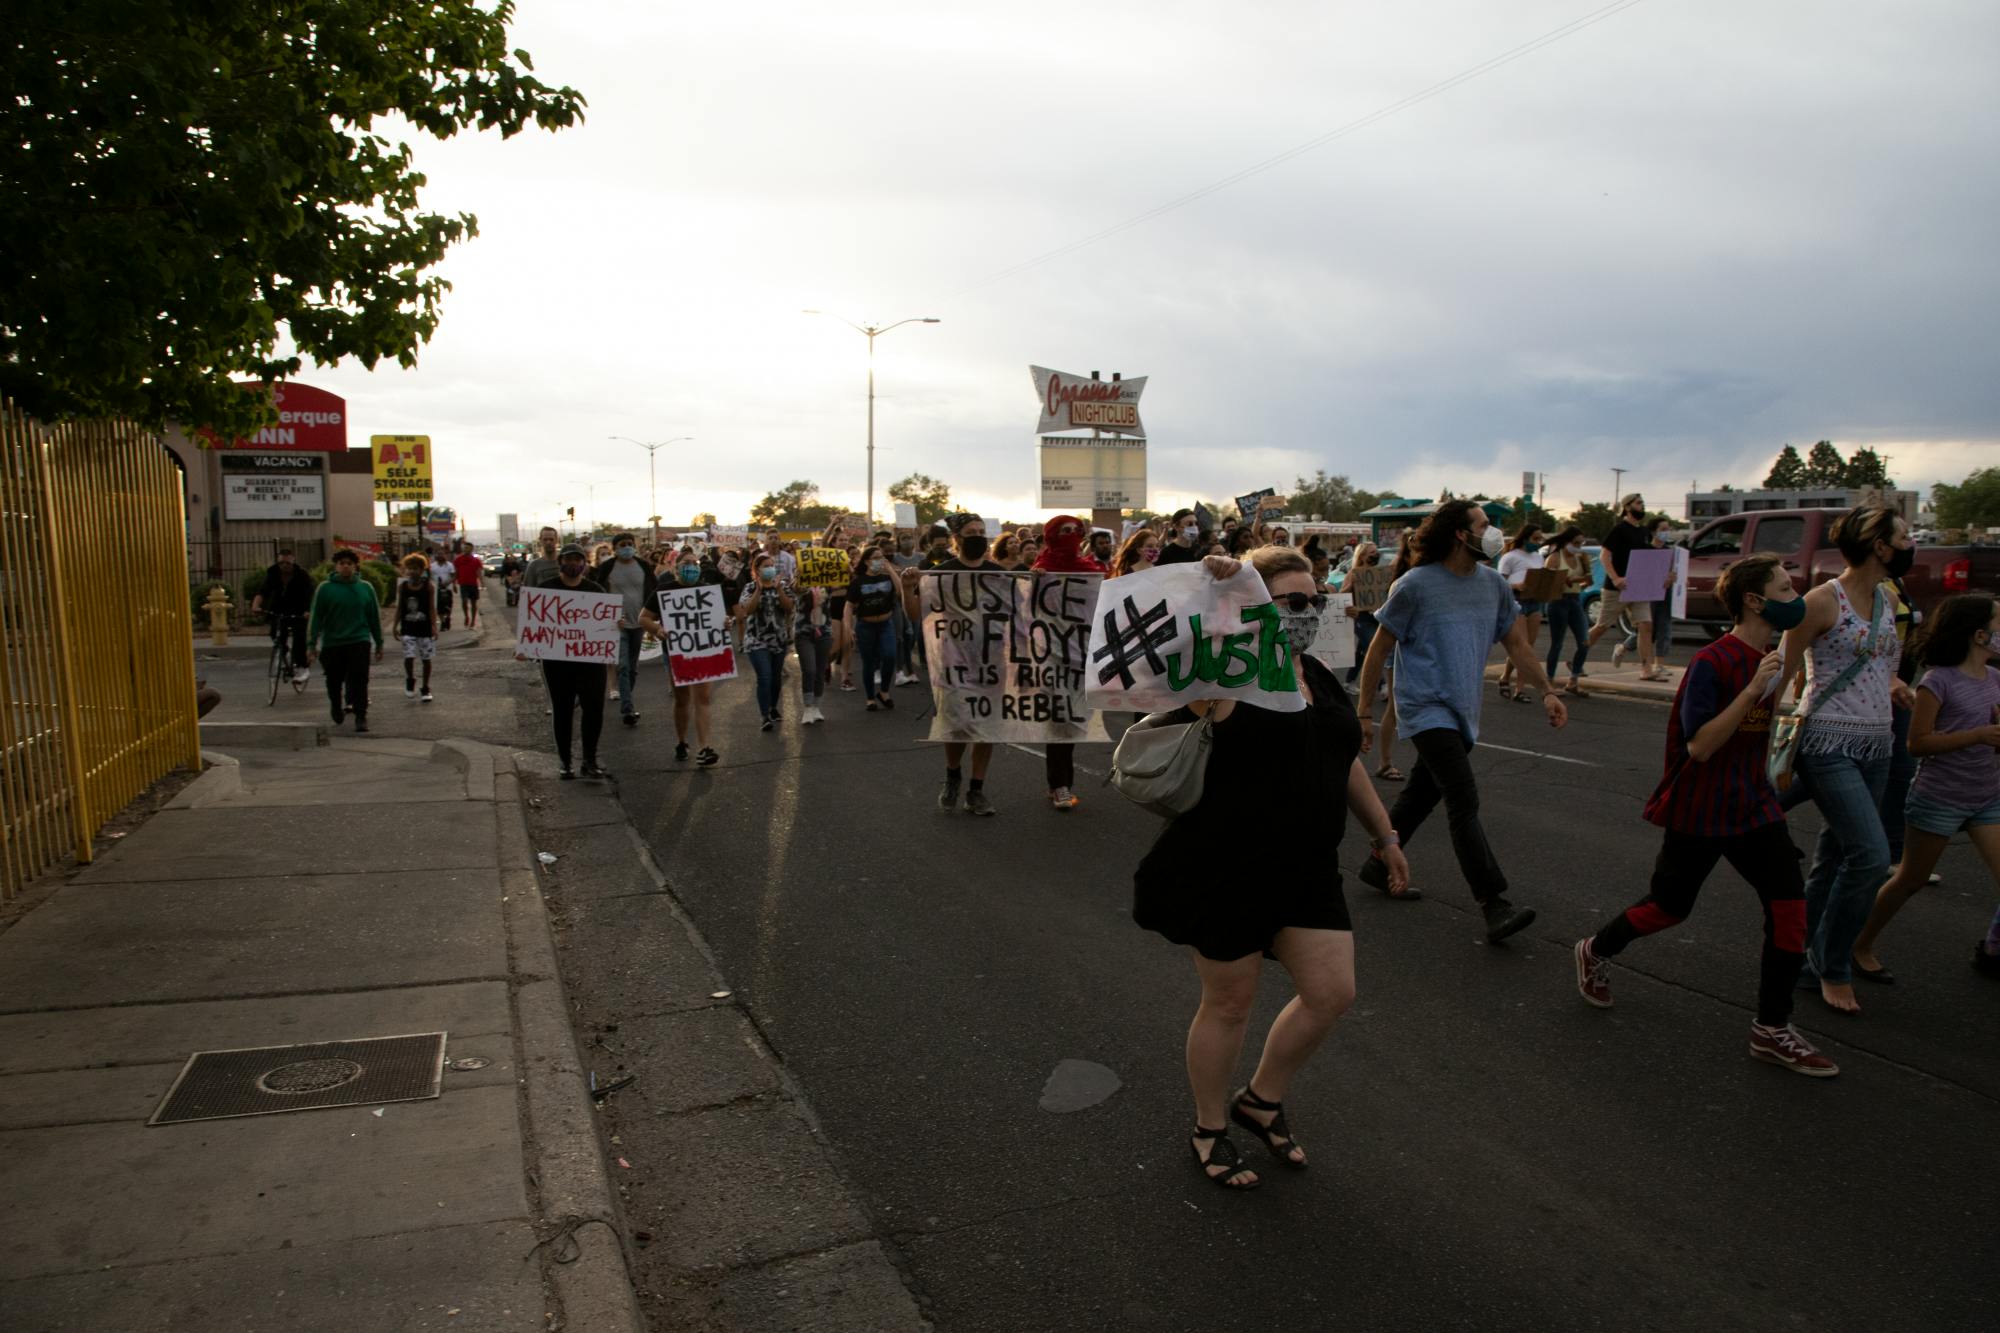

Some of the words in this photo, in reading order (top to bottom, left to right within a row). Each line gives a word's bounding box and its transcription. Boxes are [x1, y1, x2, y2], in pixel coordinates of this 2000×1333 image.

[1048, 374, 1121, 416] Caravan
[1073, 403, 1136, 424] NIGHTCLUB
[252, 428, 296, 445] INN
[253, 457, 313, 467] VACANCY
[378, 444, 424, 464] A-1
[386, 468, 418, 477] SELF
[374, 479, 431, 489] STORAGE
[929, 573, 1088, 622] JUSTICE
[592, 602, 623, 621] GET
[669, 611, 712, 630] THE
[521, 627, 556, 648] AWAY
[557, 629, 586, 641] WITH
[668, 628, 732, 652] POLICE
[935, 620, 973, 641] FOR
[566, 641, 617, 658] MURDER
[946, 666, 968, 684] IT
[979, 665, 999, 685] IS
[1018, 665, 1086, 690] RIGHT
[965, 696, 991, 718] TO
[1002, 694, 1086, 723] REBEL
